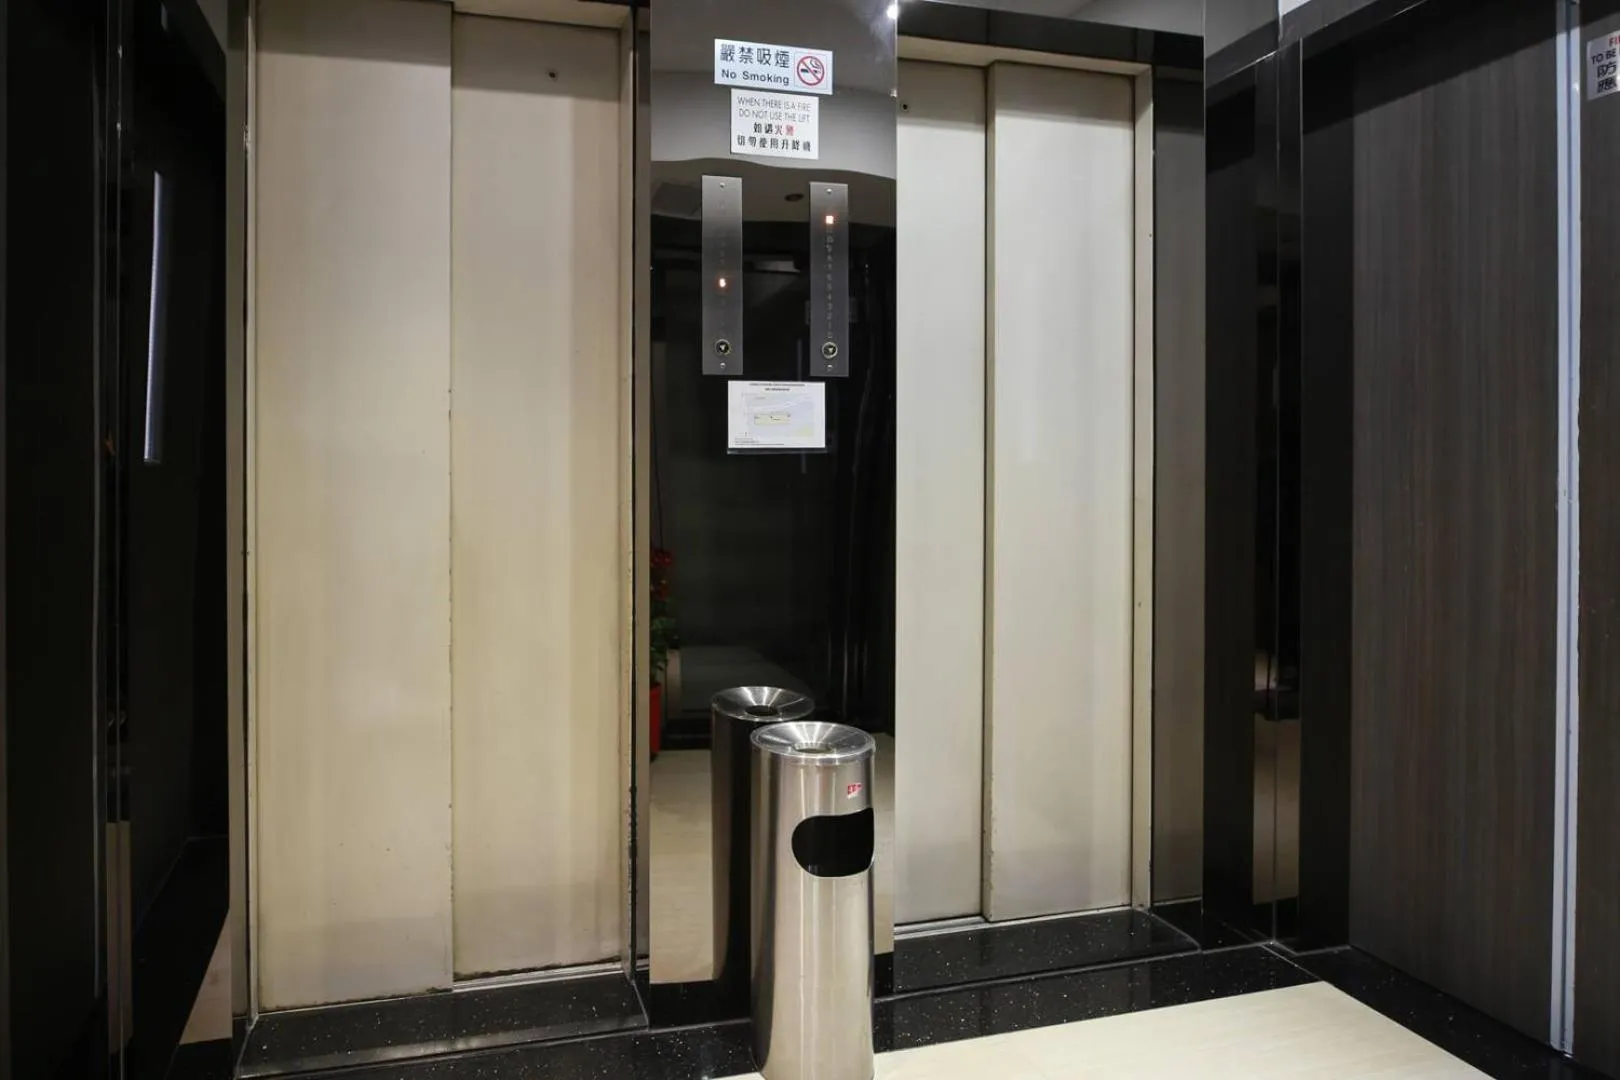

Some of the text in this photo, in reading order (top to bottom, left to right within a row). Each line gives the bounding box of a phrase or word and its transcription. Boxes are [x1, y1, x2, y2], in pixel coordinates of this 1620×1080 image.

[1608, 35, 1620, 47] FI
[720, 43, 790, 69] 嚴禁吸煙
[1591, 48, 1617, 64] TO BE
[721, 69, 790, 86] No Smoking
[737, 96, 812, 111] WHEN THERE IS A FIRE
[738, 108, 811, 123] DO NOT USE THE LIFT
[737, 134, 812, 153] 切勿使用升降機
